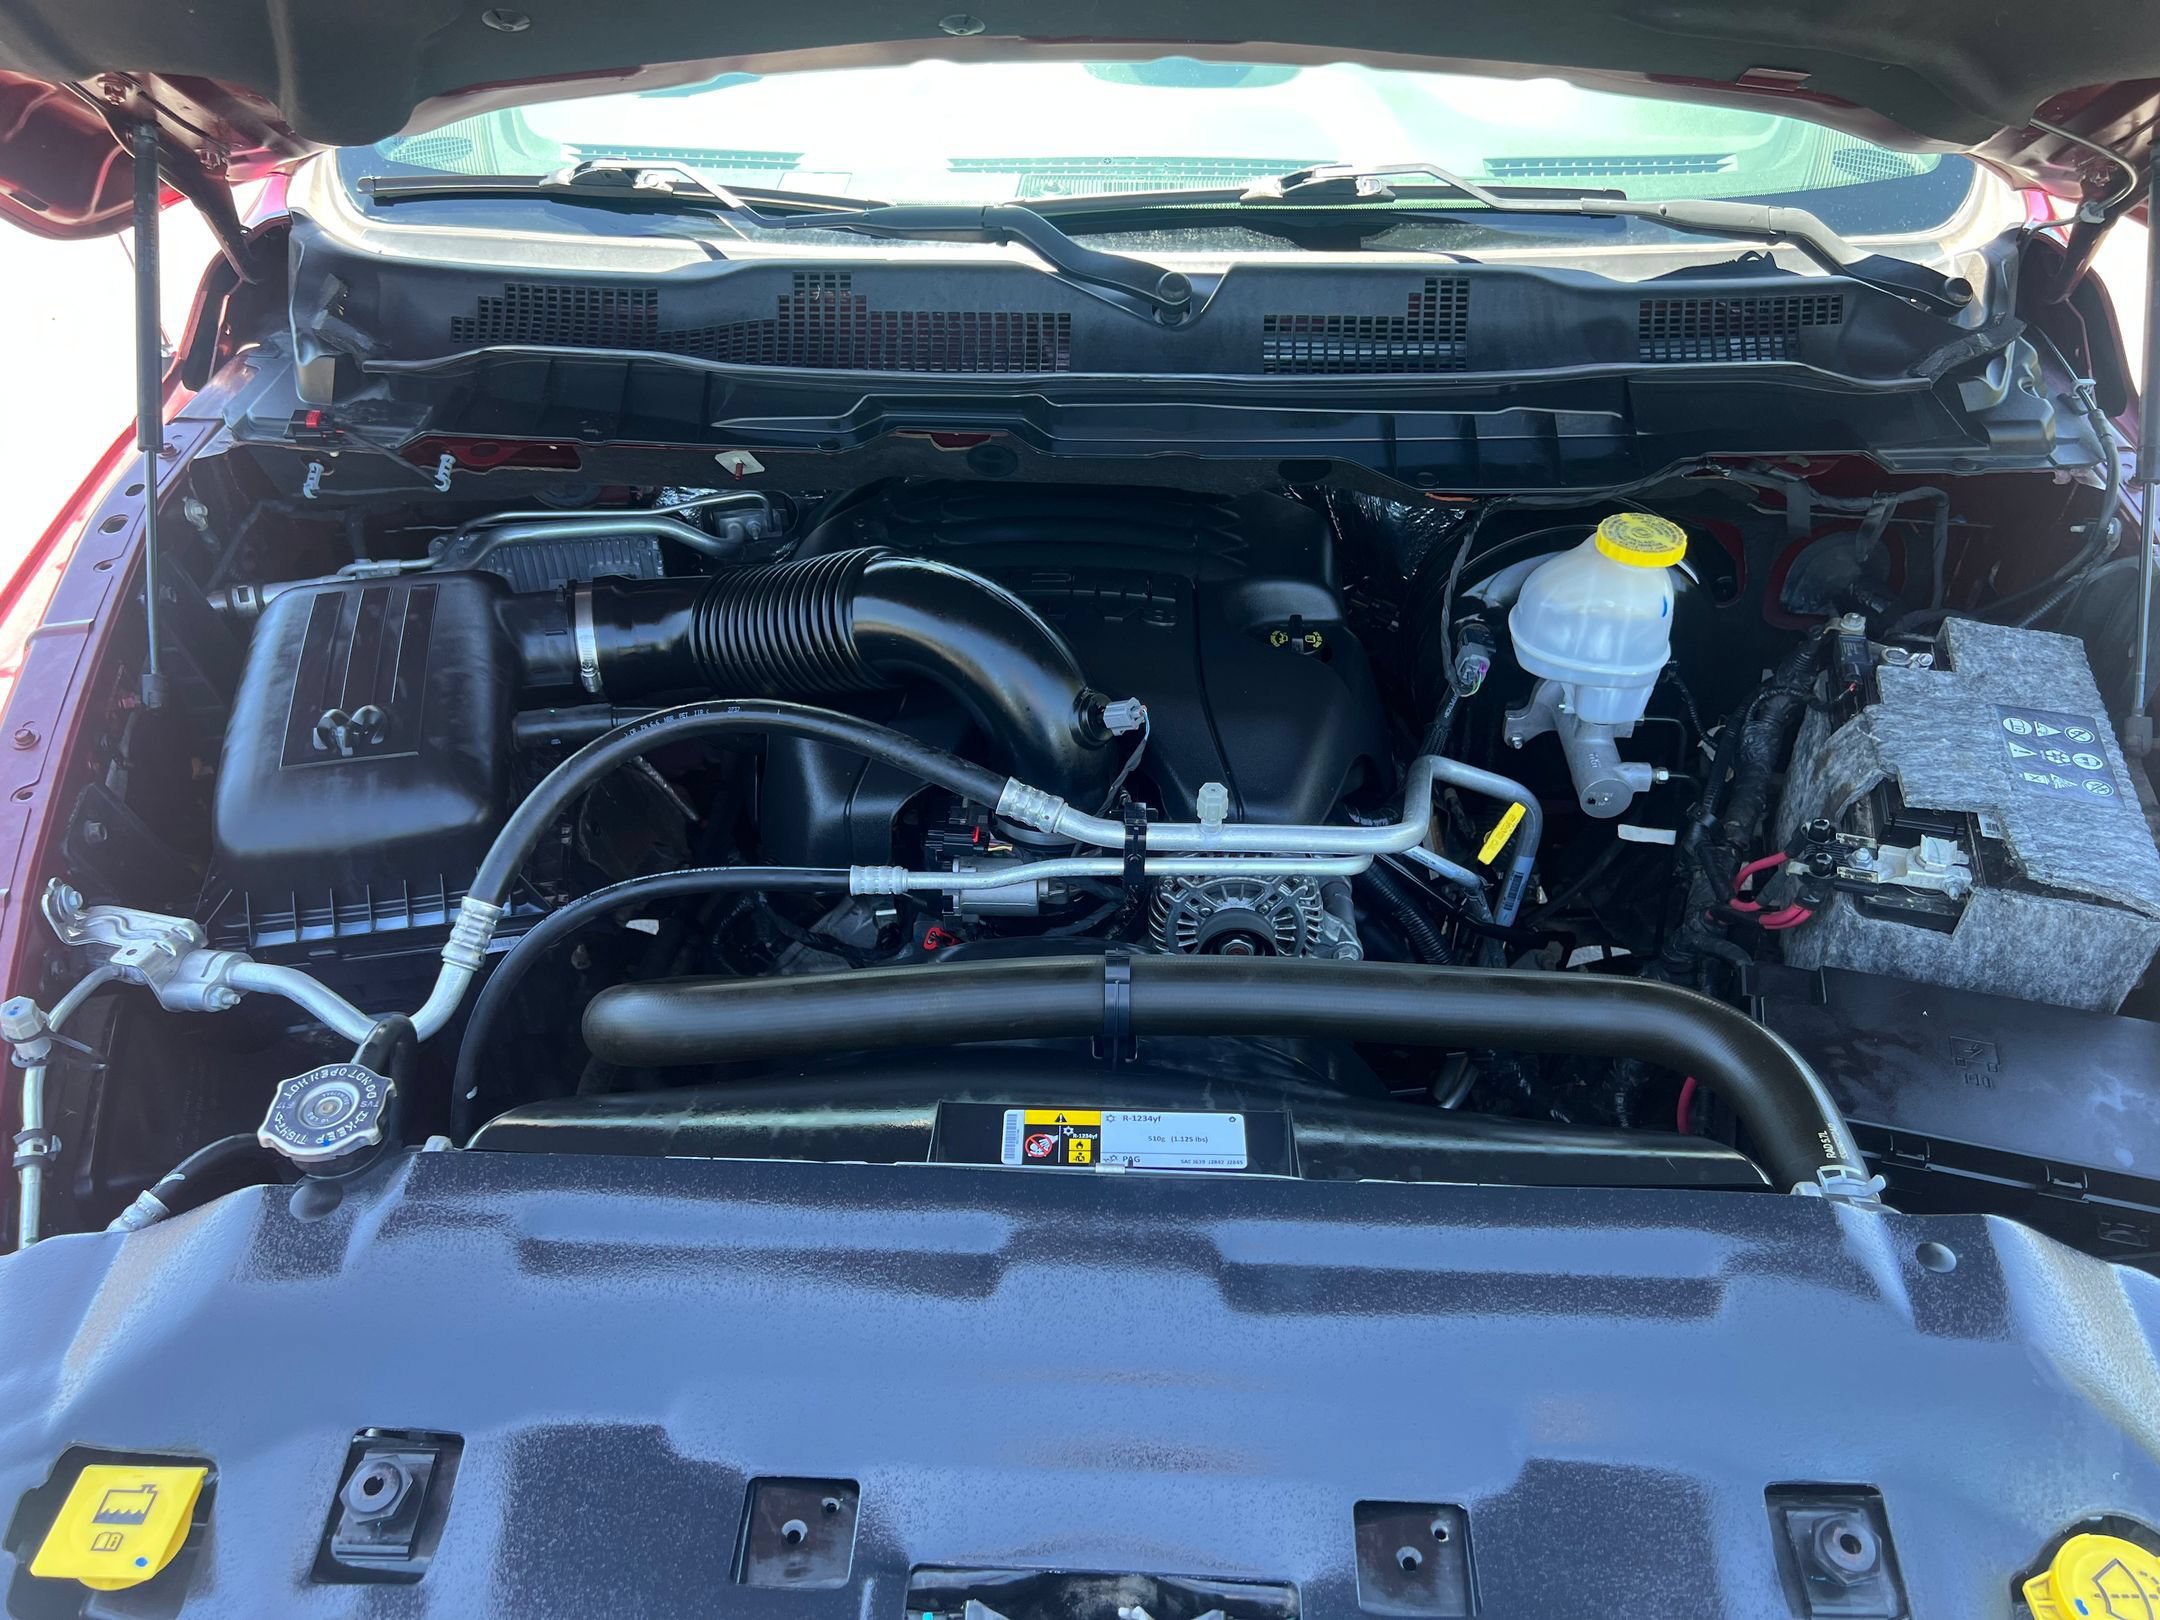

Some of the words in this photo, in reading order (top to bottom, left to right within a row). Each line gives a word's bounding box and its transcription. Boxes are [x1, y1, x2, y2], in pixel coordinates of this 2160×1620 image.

[310, 1067, 347, 1082] OPEN
[284, 1078, 309, 1099] HOT
[1122, 1115, 1162, 1124] R-1234yf
[316, 1122, 357, 1144] KEEP
[1822, 1143, 1837, 1159] RAD
[1122, 1155, 1141, 1163] PAG
